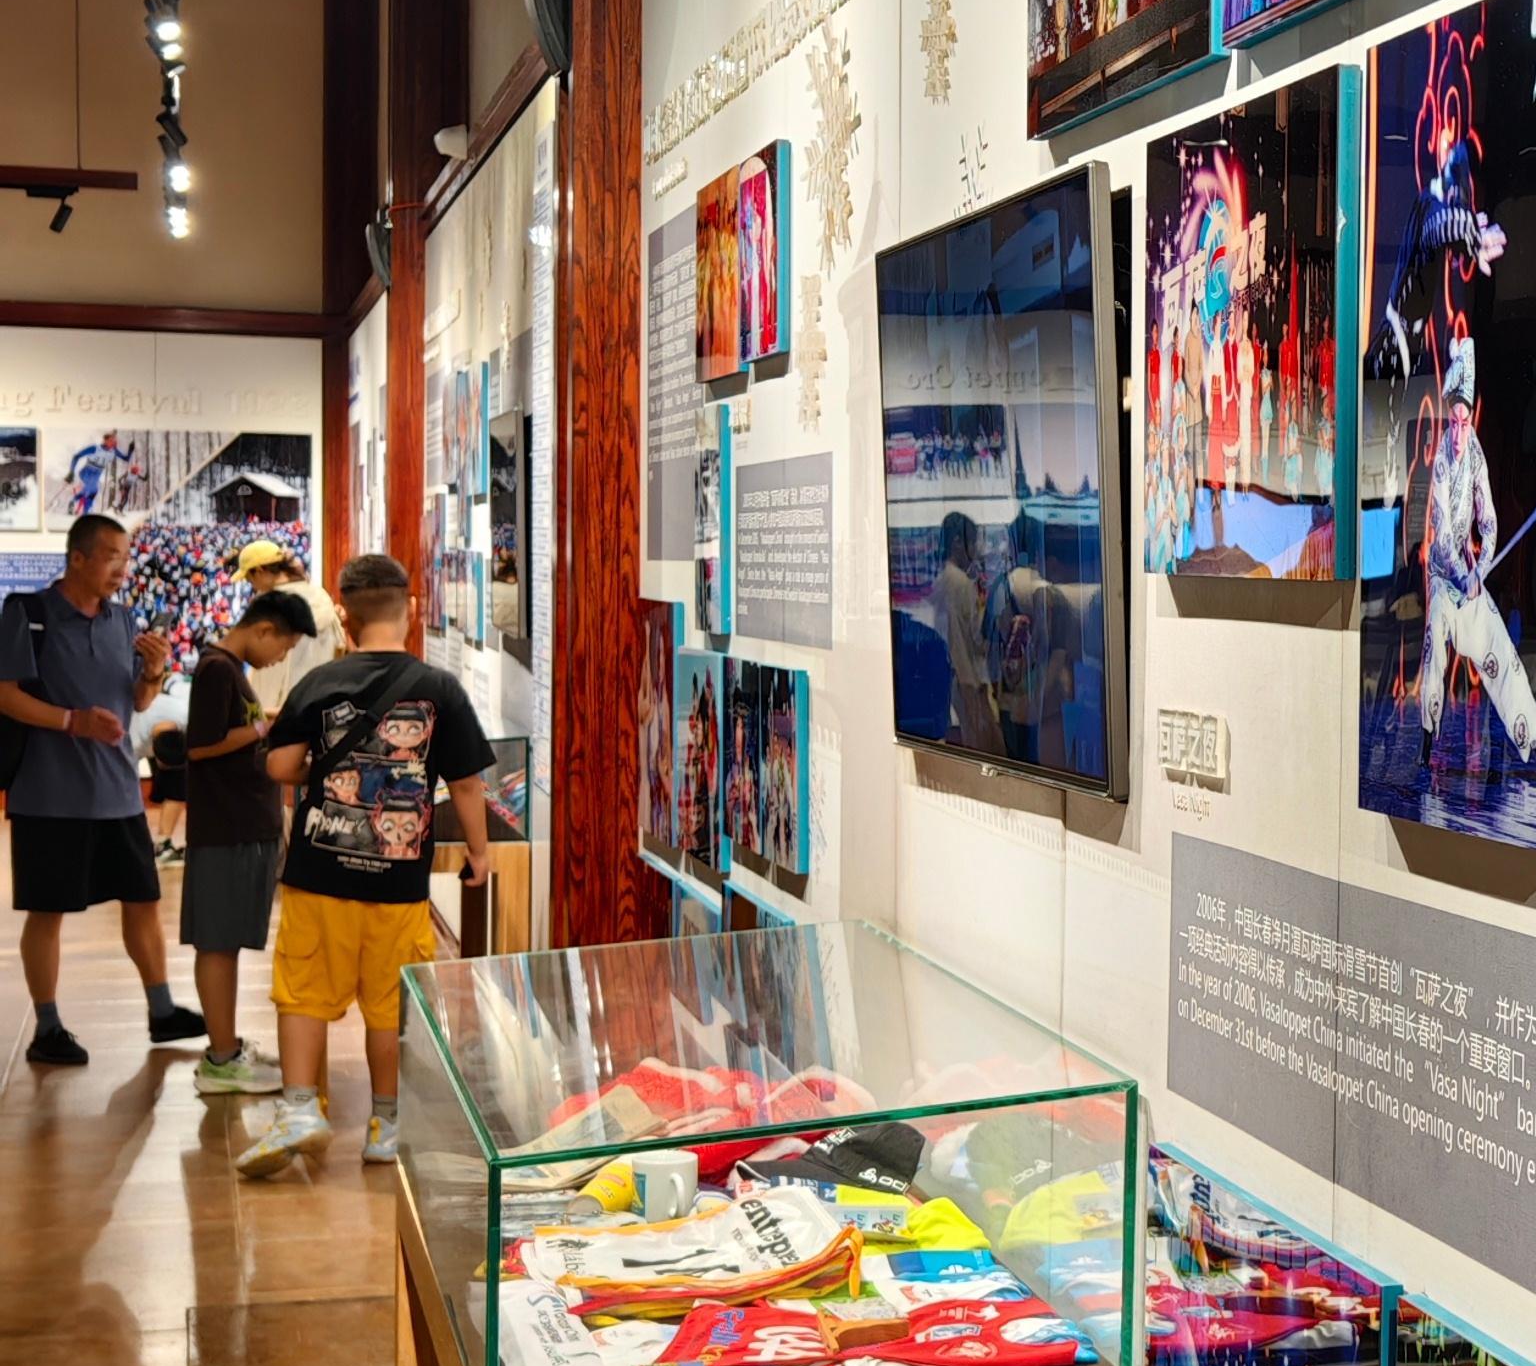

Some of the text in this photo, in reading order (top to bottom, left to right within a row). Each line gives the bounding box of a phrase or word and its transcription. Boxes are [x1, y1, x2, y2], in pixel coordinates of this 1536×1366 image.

[1178, 957, 1187, 982] In
[1188, 964, 1202, 989] the
[1203, 972, 1221, 999] year
[1222, 977, 1233, 1002] of
[1234, 979, 1259, 1017] 2006,
[1260, 990, 1312, 1040] Vasaloppet
[1313, 1014, 1343, 1053] China
[1346, 1026, 1391, 1073] initiated
[1394, 1047, 1414, 1082] the
[1178, 997, 1189, 1017] on
[1190, 997, 1234, 1040] December
[1234, 1017, 1254, 1053] 31st
[1255, 1026, 1286, 1066] before
[1287, 1044, 1304, 1076] the
[1305, 1050, 1365, 1105] Vasaloppet
[1366, 1082, 1400, 1120] China
[1402, 1101, 1454, 1153] opening
[1456, 1126, 1524, 1186] ceremony
